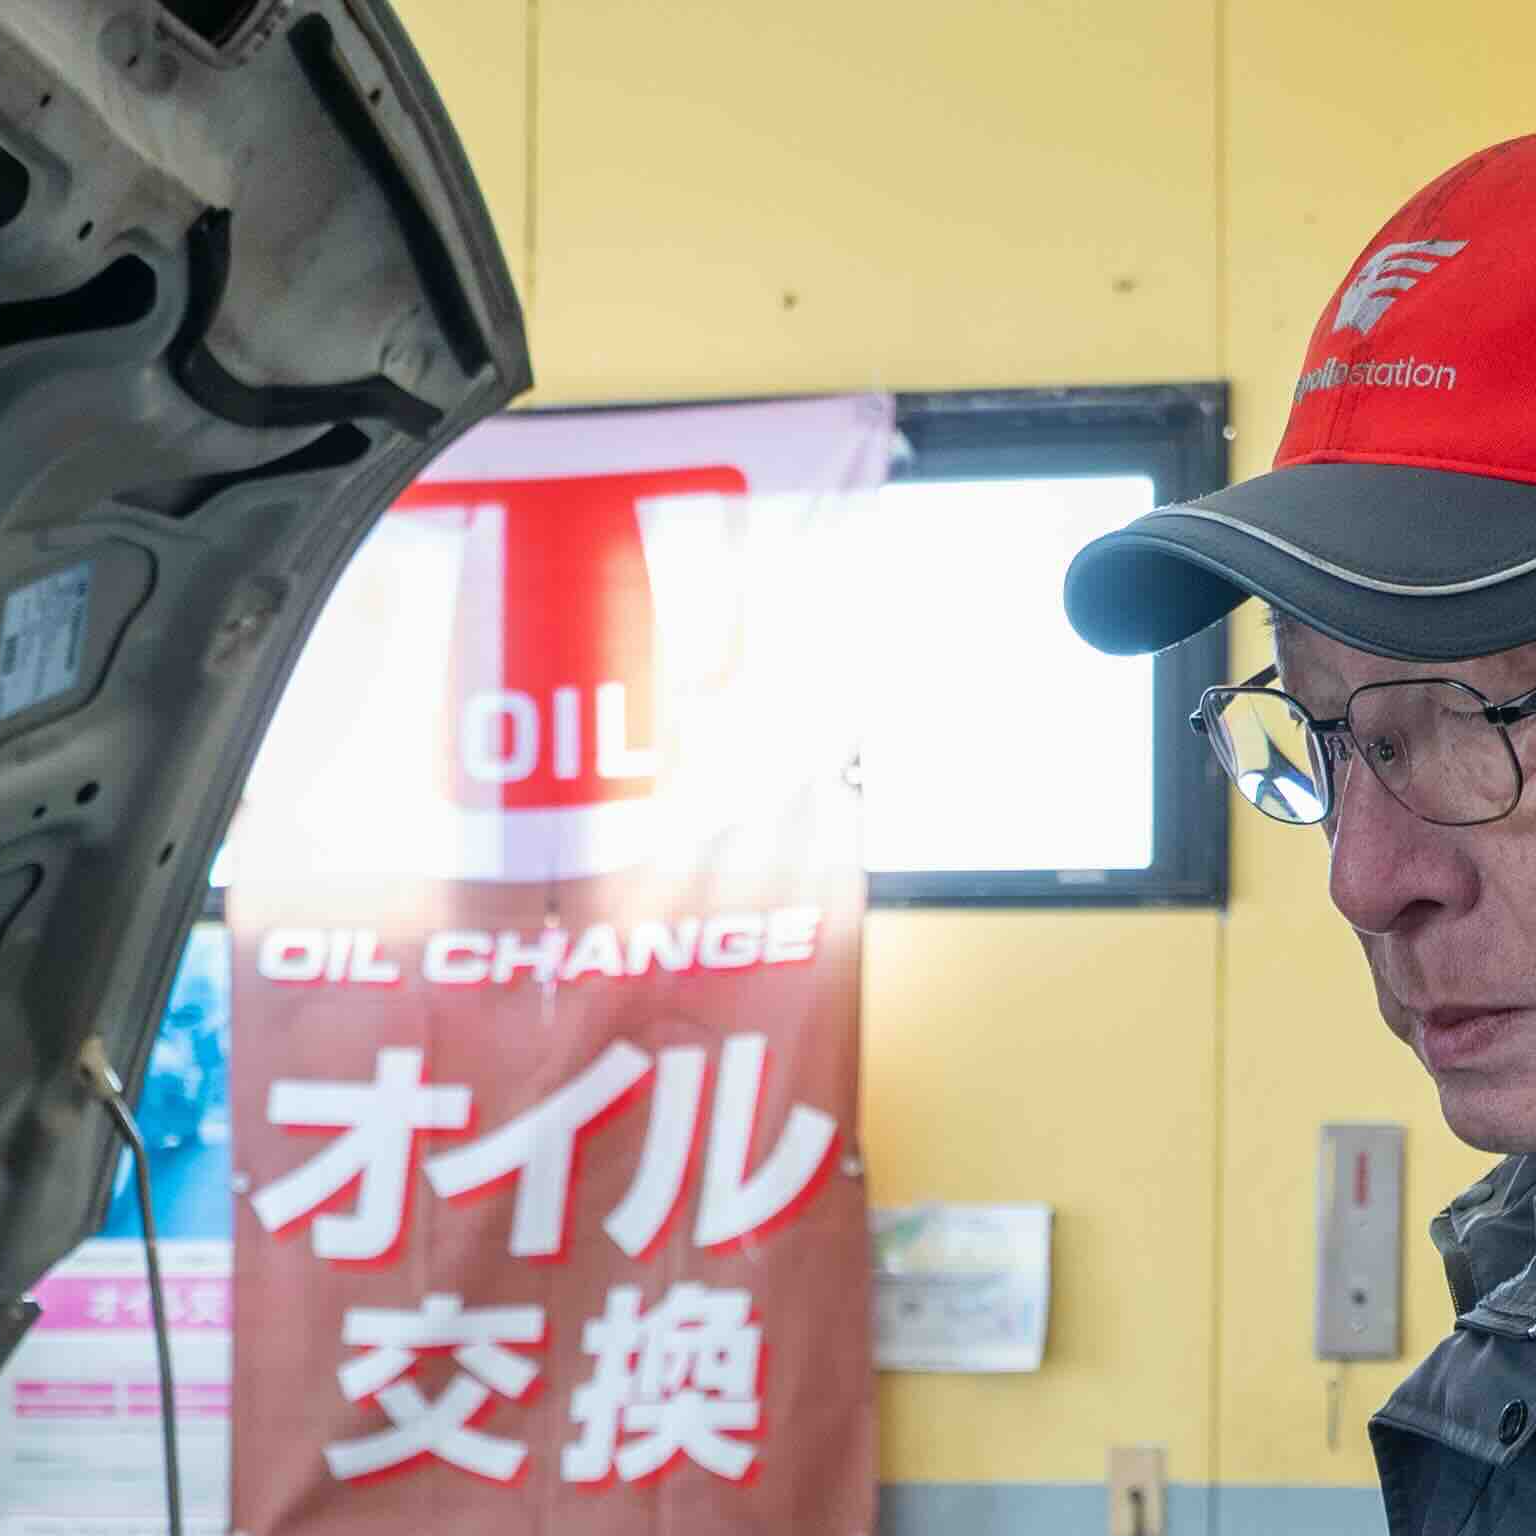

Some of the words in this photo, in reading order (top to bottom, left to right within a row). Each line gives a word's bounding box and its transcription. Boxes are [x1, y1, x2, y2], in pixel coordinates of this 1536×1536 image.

[460, 683, 662, 784] OIL
[259, 926, 401, 984] OIL
[422, 904, 821, 984] CHANGE
[249, 1032, 838, 1262] オイル
[323, 1280, 766, 1485] 交換
